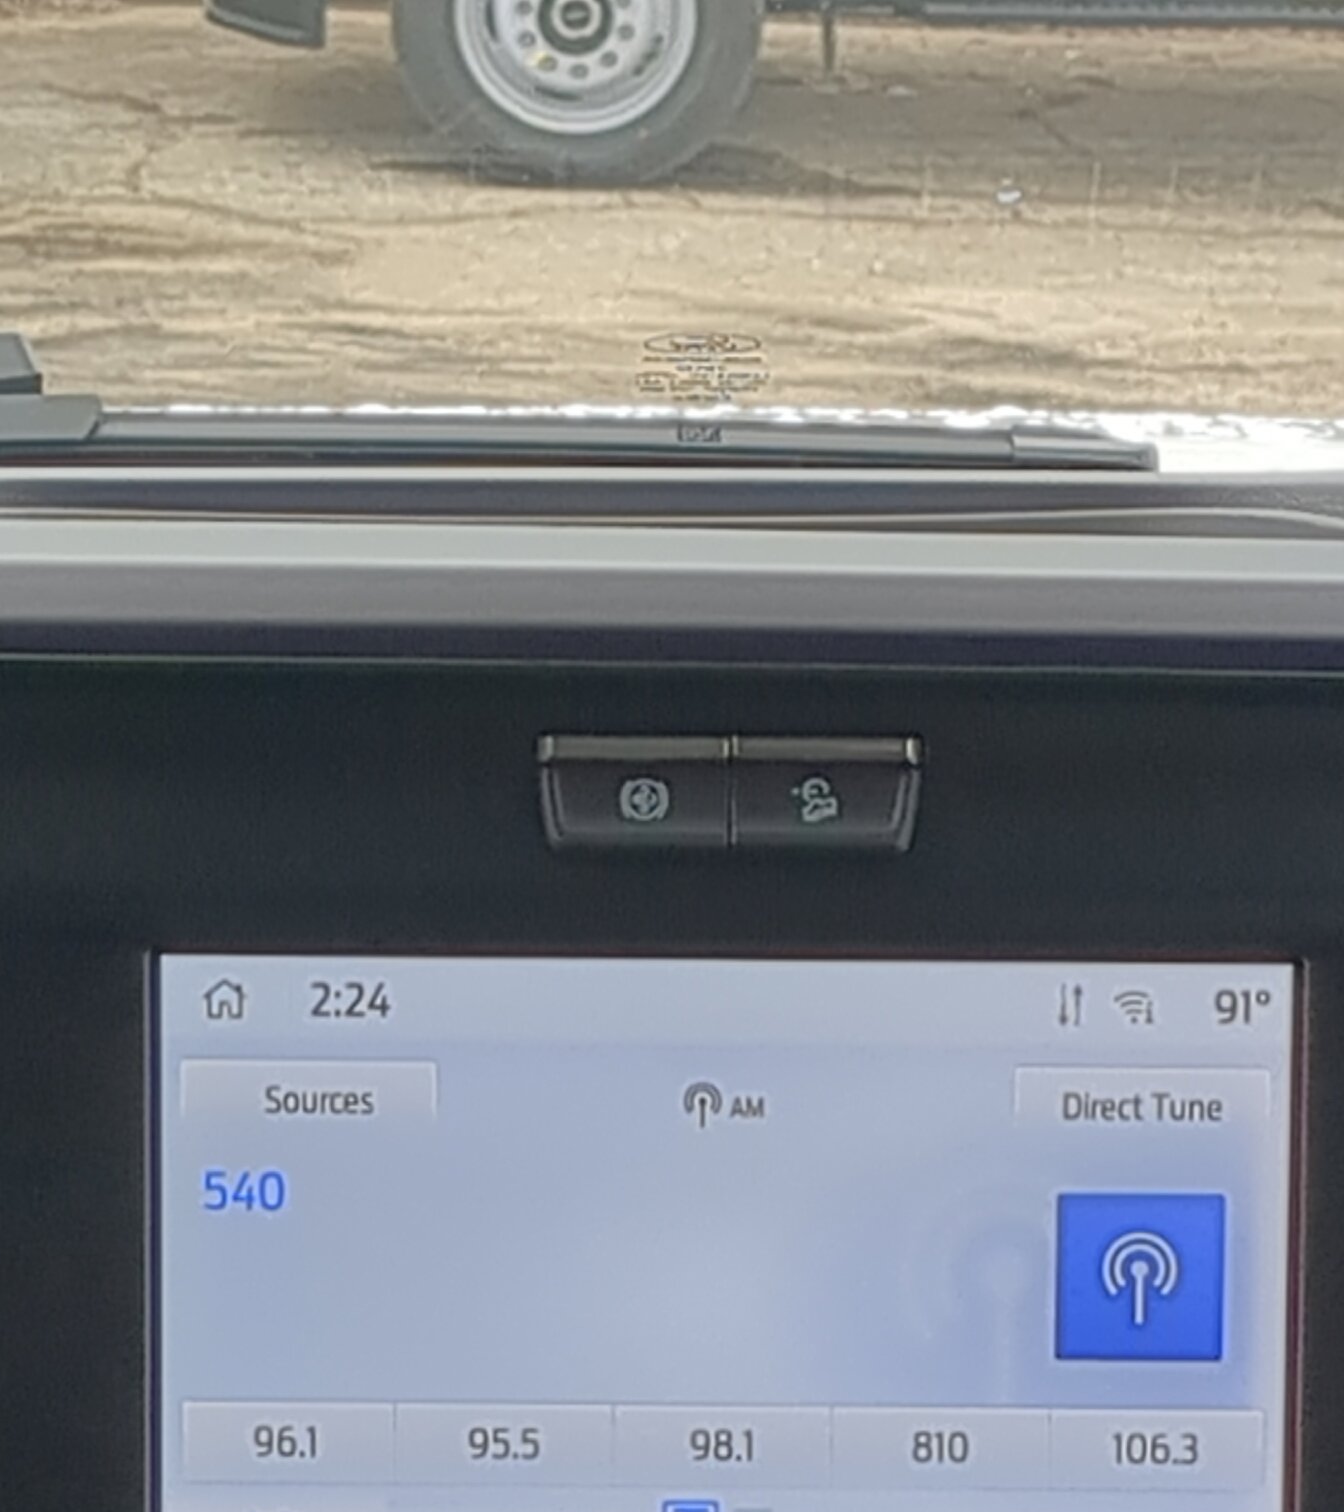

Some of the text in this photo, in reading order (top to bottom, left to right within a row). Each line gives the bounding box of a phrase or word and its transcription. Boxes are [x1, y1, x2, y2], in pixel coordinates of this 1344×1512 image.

[310, 981, 391, 1019] 2:24
[1213, 988, 1272, 1026] 91°
[264, 1084, 376, 1115] Sources
[729, 1096, 766, 1119] AM
[1062, 1091, 1224, 1122] Direct Tune
[203, 1169, 286, 1212] 540
[253, 1425, 318, 1460] 96.1
[468, 1426, 541, 1462] 95.5
[689, 1429, 755, 1463] 98.1
[911, 1431, 969, 1464] 810
[1111, 1431, 1200, 1466] 106.3
